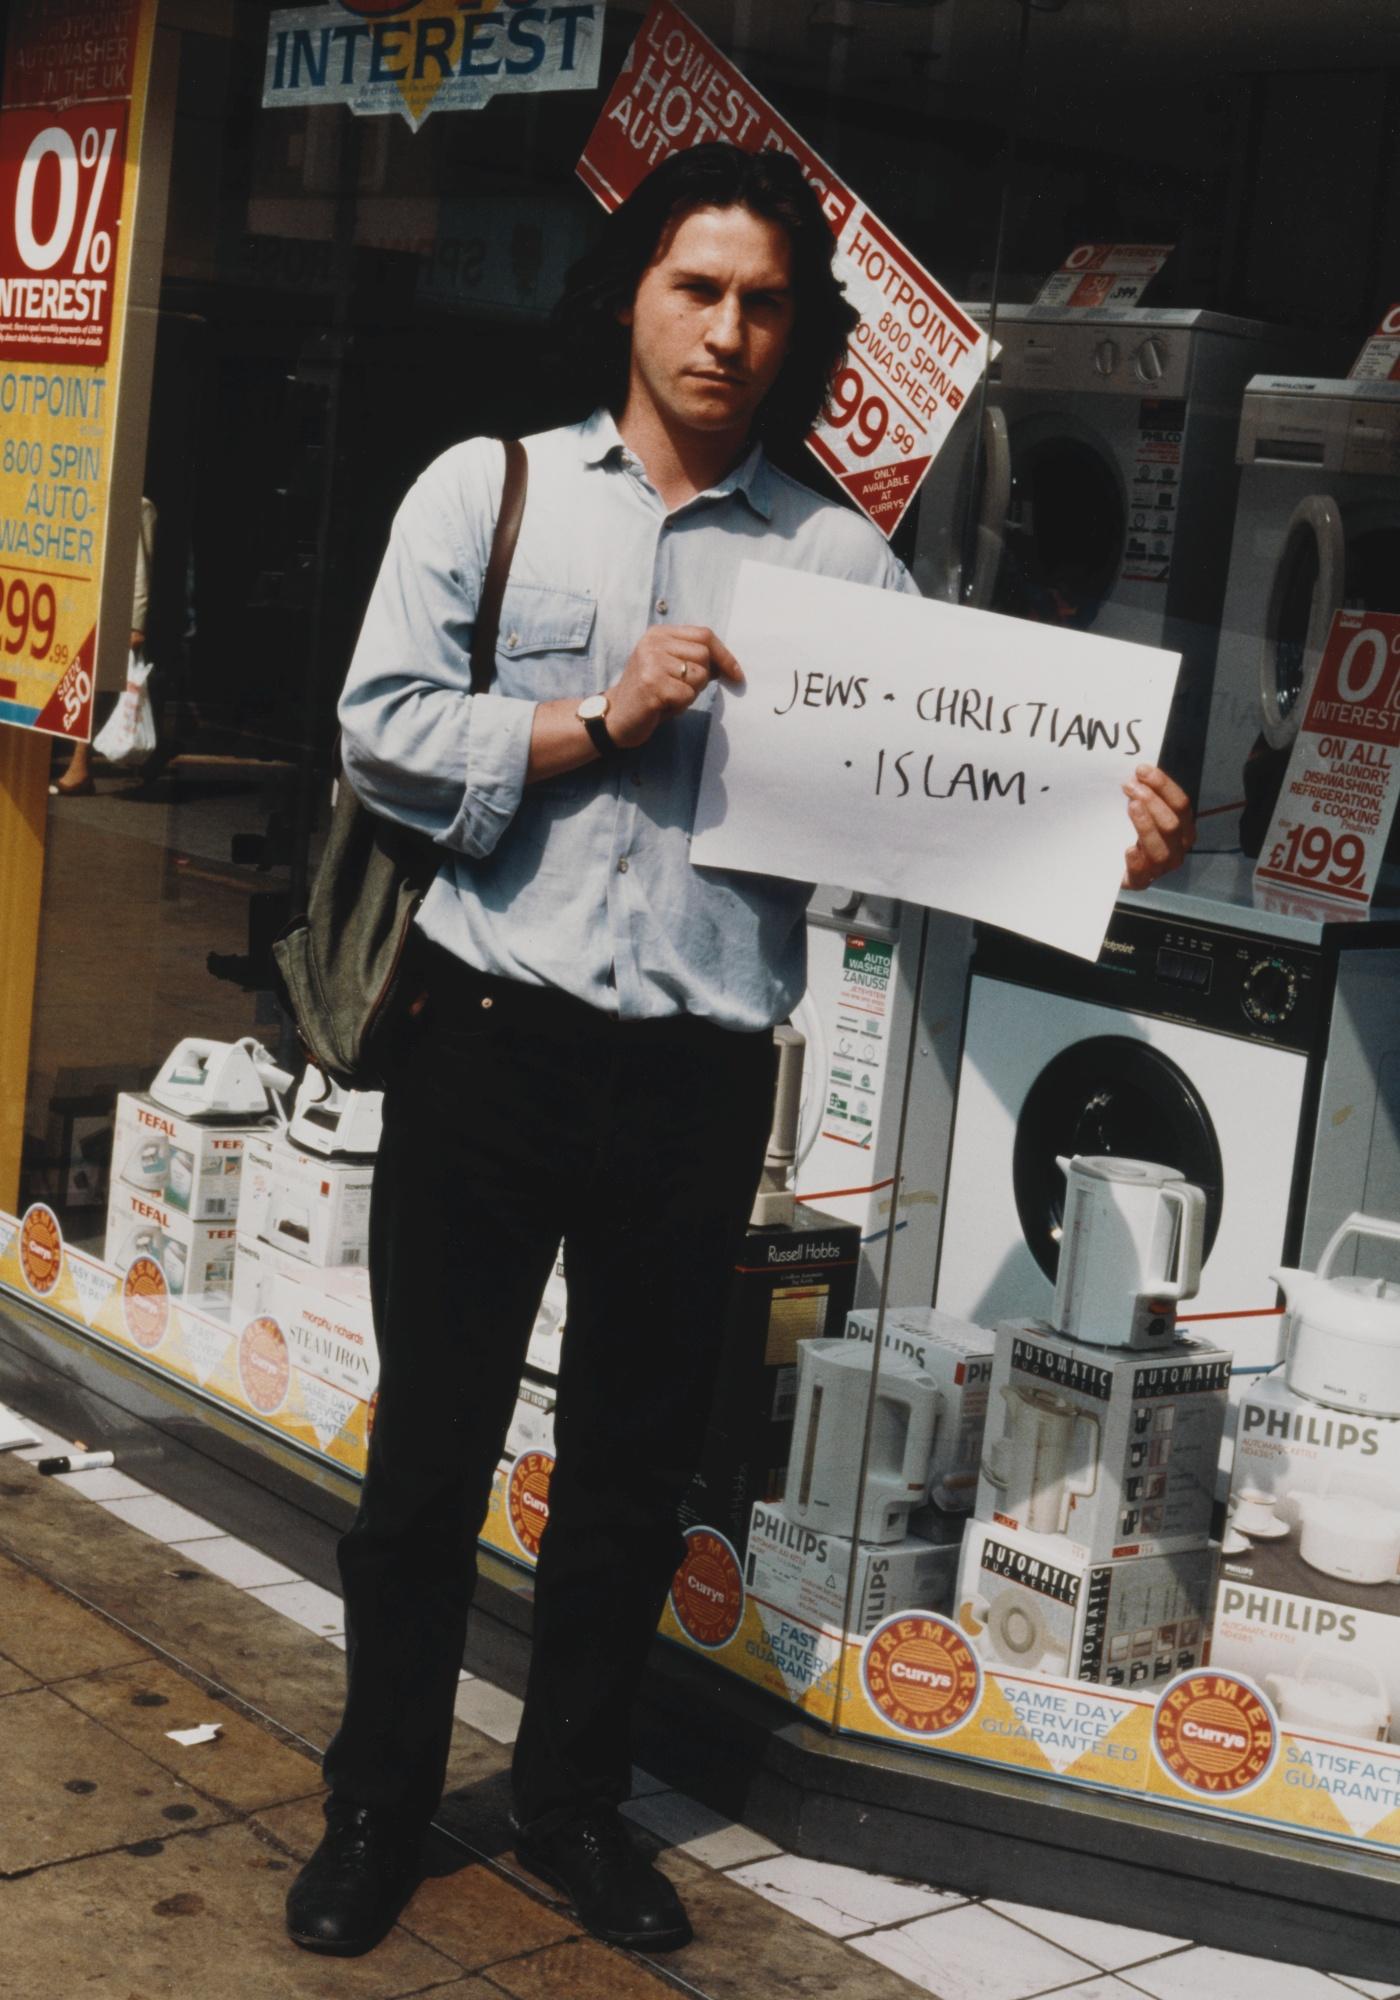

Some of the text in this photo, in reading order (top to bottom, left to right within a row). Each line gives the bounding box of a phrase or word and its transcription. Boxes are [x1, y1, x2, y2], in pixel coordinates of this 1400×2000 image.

[272, 5, 594, 90] INTEREST
[64, 66, 97, 92] THE
[102, 64, 126, 89] UK
[648, 11, 760, 143] LOWEST
[632, 53, 736, 147] HOT
[608, 96, 680, 165] AUT
[15, 127, 117, 274] 0%
[0, 279, 107, 321] NTEREST
[847, 231, 970, 367] HOTPOINT
[855, 323, 938, 421] OWASHER
[878, 311, 952, 398] 800 SPIN
[1142, 431, 1182, 443] PHILCO
[3, 439, 100, 481] 800 SPIN
[874, 467, 897, 480] ONLY
[25, 483, 96, 521] AUTO-
[862, 475, 910, 494] AVAILABLE
[881, 490, 892, 501] AT
[869, 499, 905, 515] CURRYS
[0, 519, 94, 564] WASHER
[0, 577, 68, 665] 99.99
[774, 670, 869, 715] JEWS
[915, 686, 1142, 756] CHRISTIANS
[1317, 736, 1392, 770] ON ALL
[1303, 770, 1386, 799] DISHWASHING,
[1330, 761, 1390, 786] LAUNDRY,
[1290, 782, 1382, 814] REFRIGERATION,
[1311, 802, 1380, 826] & COOKING
[848, 958, 890, 977] WASHER
[864, 952, 891, 967] AUTO
[842, 970, 888, 991] ZANUSSI
[137, 1109, 177, 1138] TEFAL
[130, 1197, 170, 1228] TEFAL
[768, 1241, 841, 1263] Russell Hobbs
[302, 1310, 364, 1345] morphy richards
[290, 1326, 370, 1376] STEAM IRON
[1014, 1340, 1109, 1388] AUTOMATIC
[1049, 1370, 1106, 1398] KETTLE
[1137, 1362, 1231, 1386] AUTOMATIC
[1242, 1403, 1380, 1457] PHILIPS
[523, 1491, 550, 1519] Curry
[752, 1509, 828, 1563] PHILIPS
[983, 1558, 1075, 1605] JUG KETTLE
[984, 1541, 1080, 1594] AUTOMATIC
[1225, 1564, 1254, 1576] PHILIPS
[687, 1575, 726, 1603] Currys
[1081, 1570, 1104, 1683] UTOMATIC
[1222, 1588, 1357, 1642] PHILIPS
[780, 1621, 818, 1651] FAST
[868, 1620, 977, 1690] PREMIER
[891, 1662, 952, 1688] Currys
[869, 1676, 970, 1730] SERVICE
[1003, 1687, 1124, 1723] SAME DAY
[1158, 1678, 1271, 1749] PREMIER
[980, 1717, 1138, 1762] GUARANTEED
[1013, 1706, 1109, 1739] SERVICE
[1182, 1722, 1247, 1749] Currys
[1159, 1736, 1264, 1790] SERVICE
